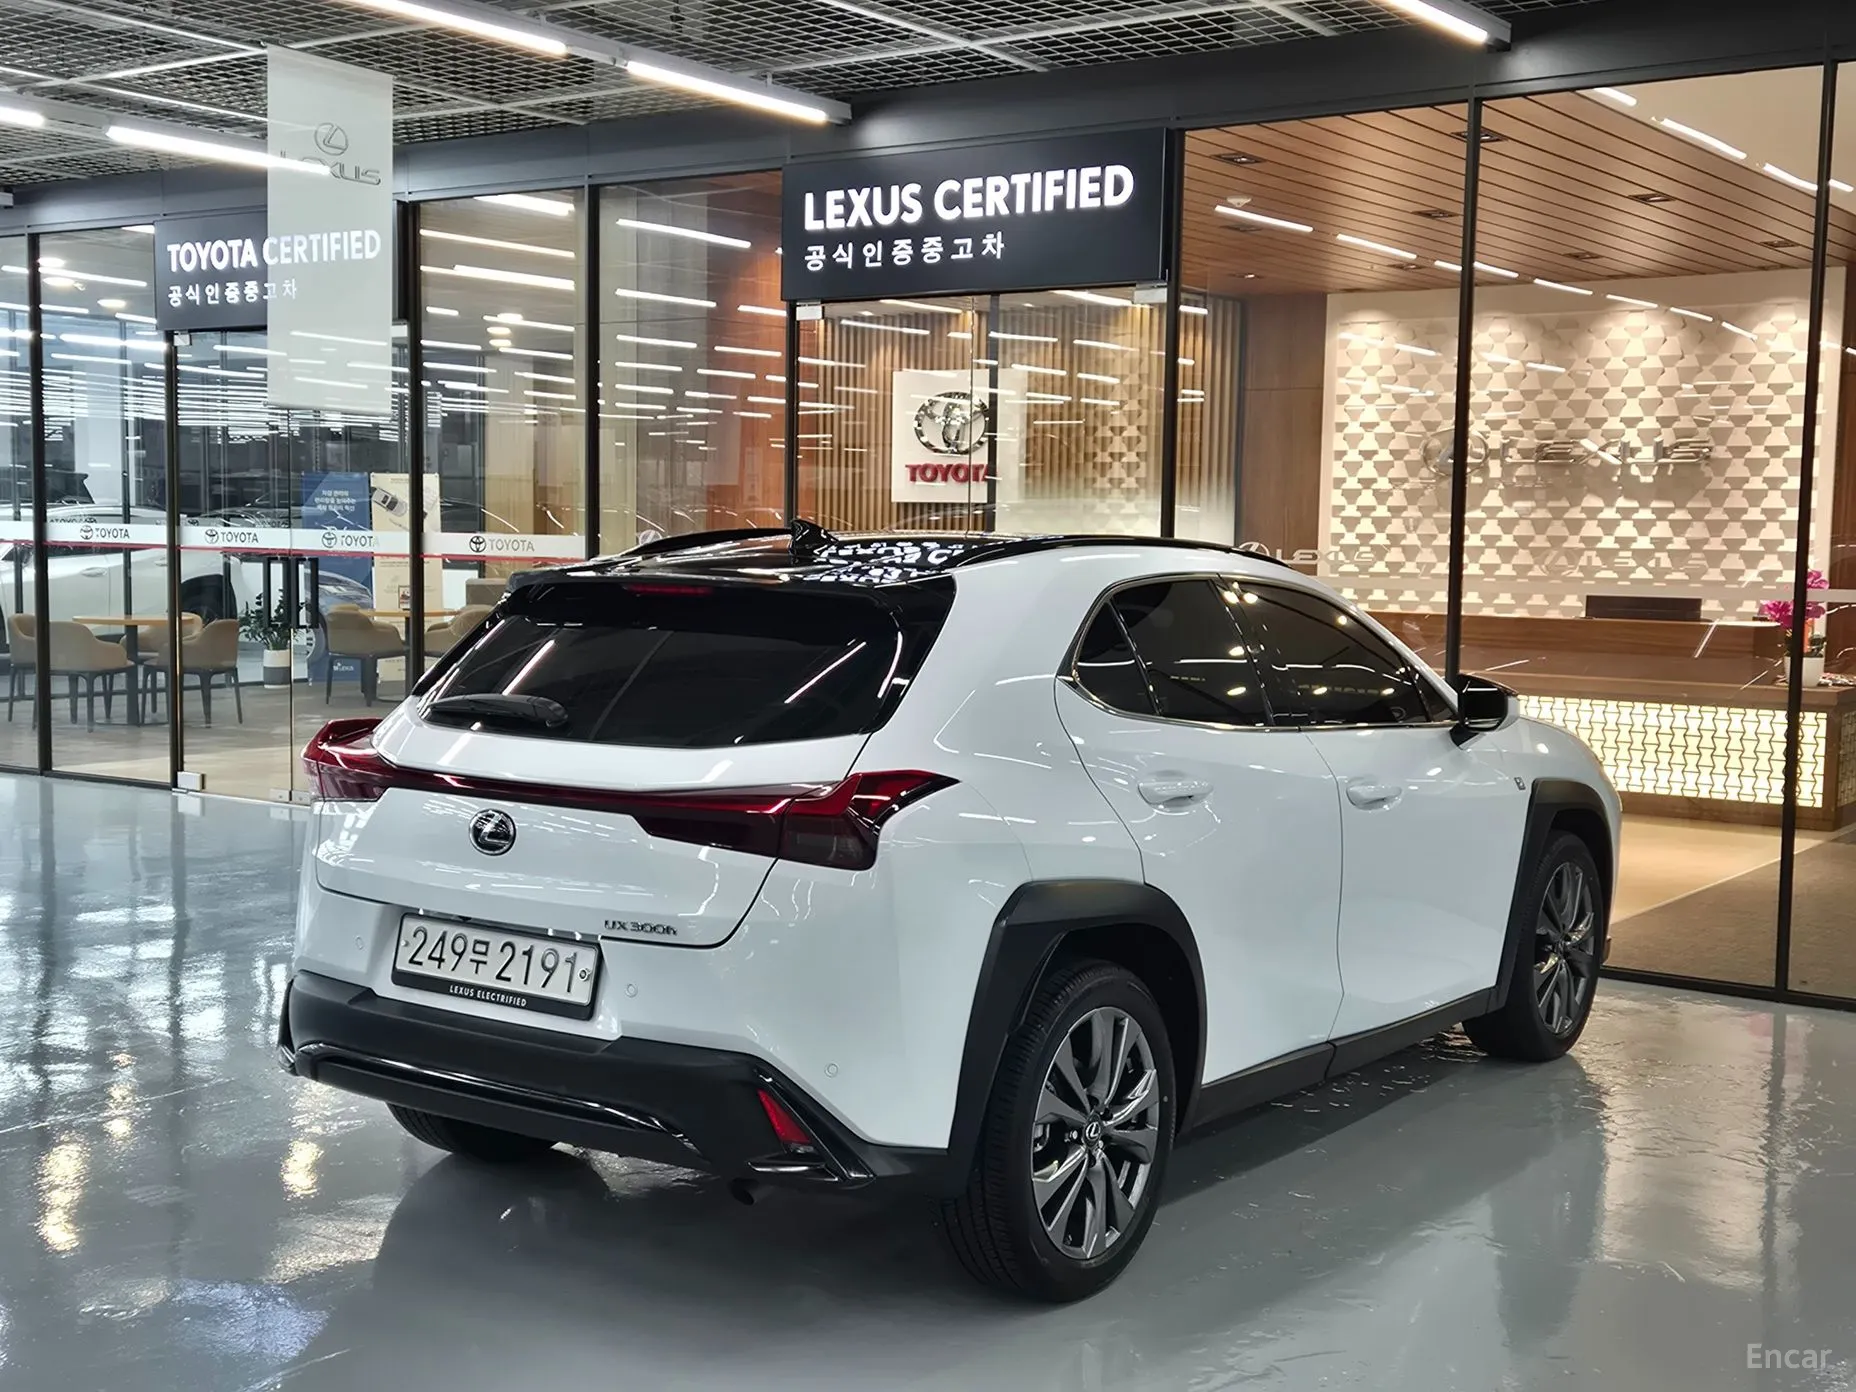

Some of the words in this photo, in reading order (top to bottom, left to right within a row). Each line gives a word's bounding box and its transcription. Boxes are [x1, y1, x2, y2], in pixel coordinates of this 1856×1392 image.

[804, 183, 923, 231] LEXUS
[934, 164, 1136, 221] CERTIFIED
[167, 238, 259, 272] TOYOTA
[262, 229, 382, 266] CERTIFIED
[804, 231, 1004, 271] 공식인증중고차
[1500, 437, 1712, 465] LEXUS
[95, 527, 130, 539] TOYOTA
[220, 531, 259, 544] TOYOTA
[489, 538, 535, 553] TOYOTA
[604, 919, 629, 931] UX
[630, 921, 678, 936] 300h
[495, 941, 579, 994] 2191
[449, 984, 475, 998] LEXUS
[476, 989, 527, 1007] ELECTRIFIED
